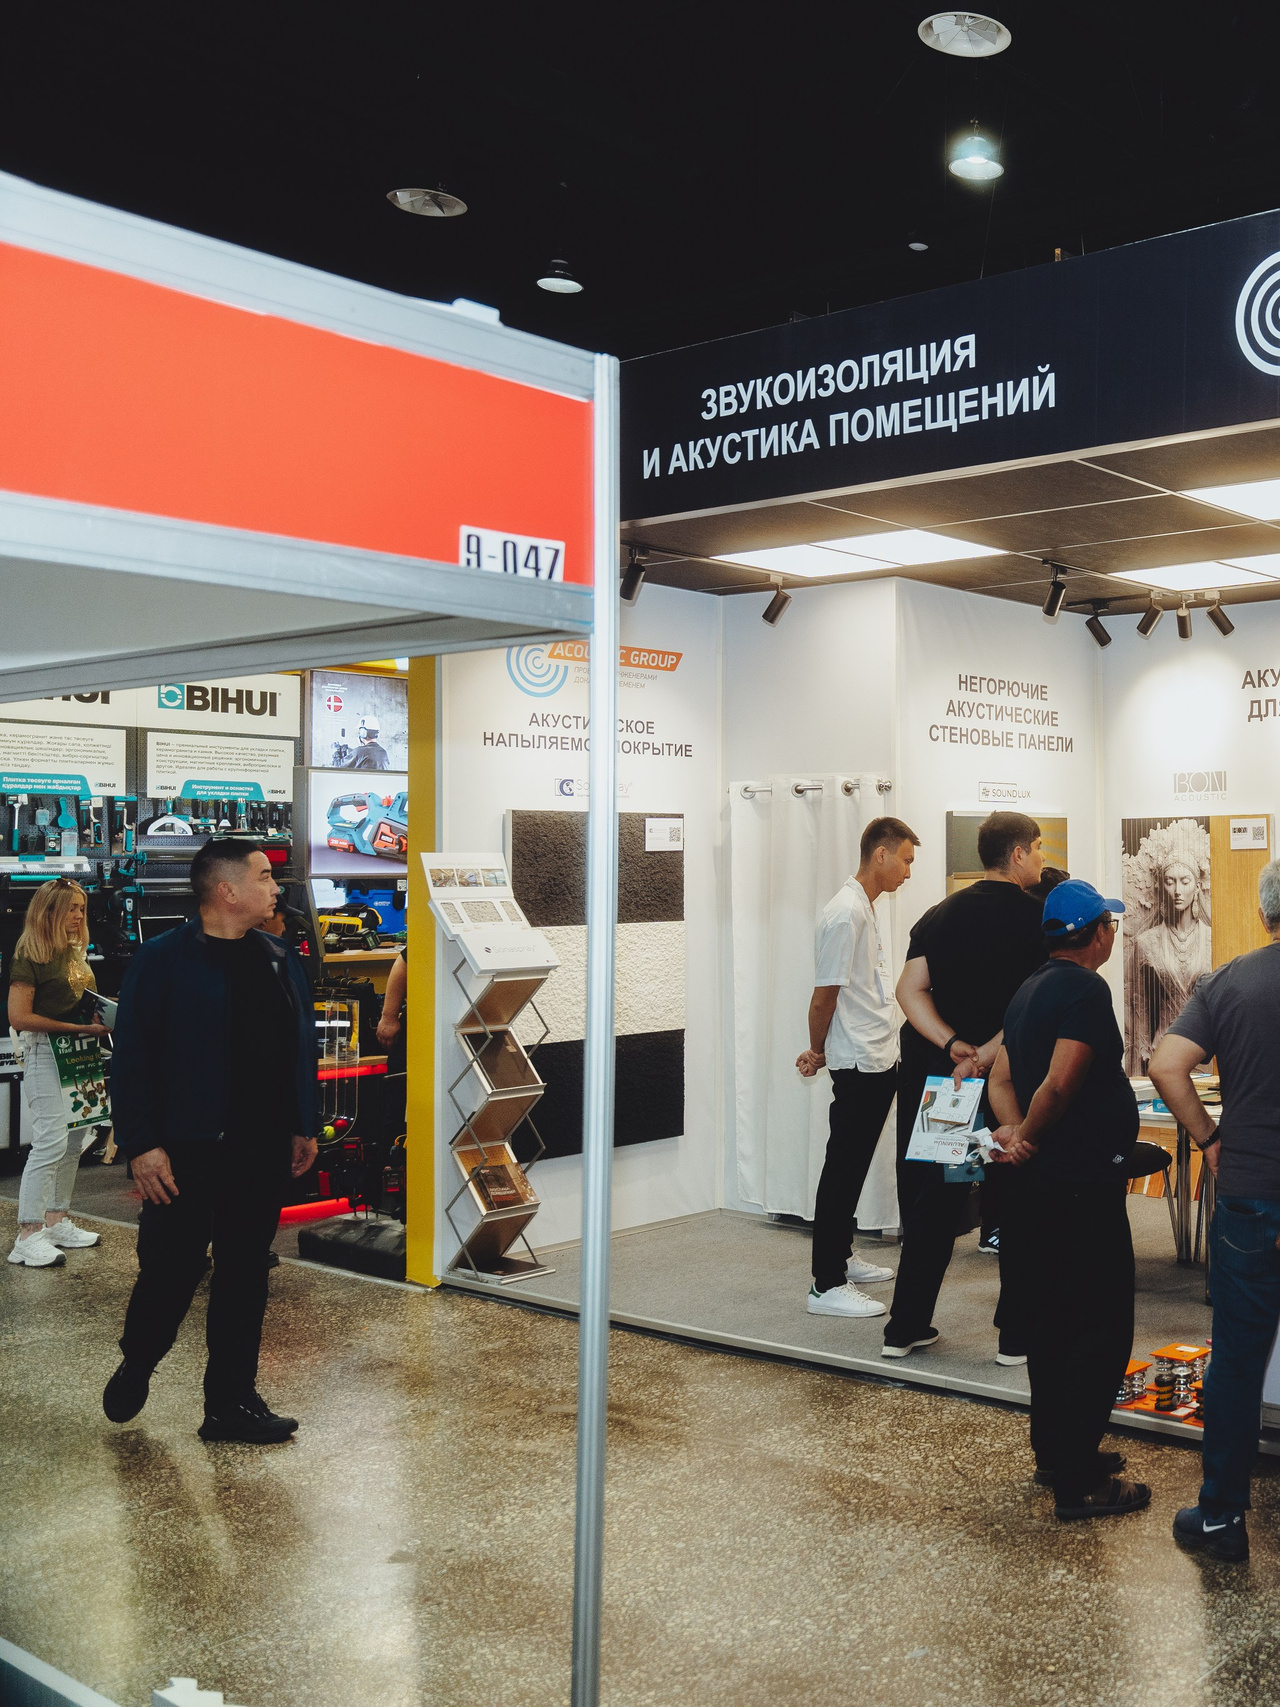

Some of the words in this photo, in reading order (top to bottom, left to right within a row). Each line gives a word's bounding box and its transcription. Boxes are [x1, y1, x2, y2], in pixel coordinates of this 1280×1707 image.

[700, 333, 976, 421] ЗВУКОИЗОЛЯЦИЯ
[642, 446, 660, 479] И
[667, 418, 820, 476] АКУСТИКА
[829, 363, 1056, 447] ПОМЕЩЕНИЙ
[553, 643, 627, 663] ACOUC
[629, 649, 677, 668] GROUP
[186, 684, 278, 717] BIHUI
[958, 673, 1048, 701] НЕГОРЮЧИЕ
[529, 712, 655, 735] АКУСТИСКОЕ
[945, 699, 1059, 727] АКУСТИЧЕСКИЕ
[483, 731, 590, 752] НАПЫЛЯЕМО
[928, 724, 1014, 749] СТЕНОВЫЕ
[1018, 733, 1074, 753] ПАНЕЛИ
[991, 788, 1031, 799] SOUNDLUX
[1174, 792, 1227, 802] ACOUSTIC
